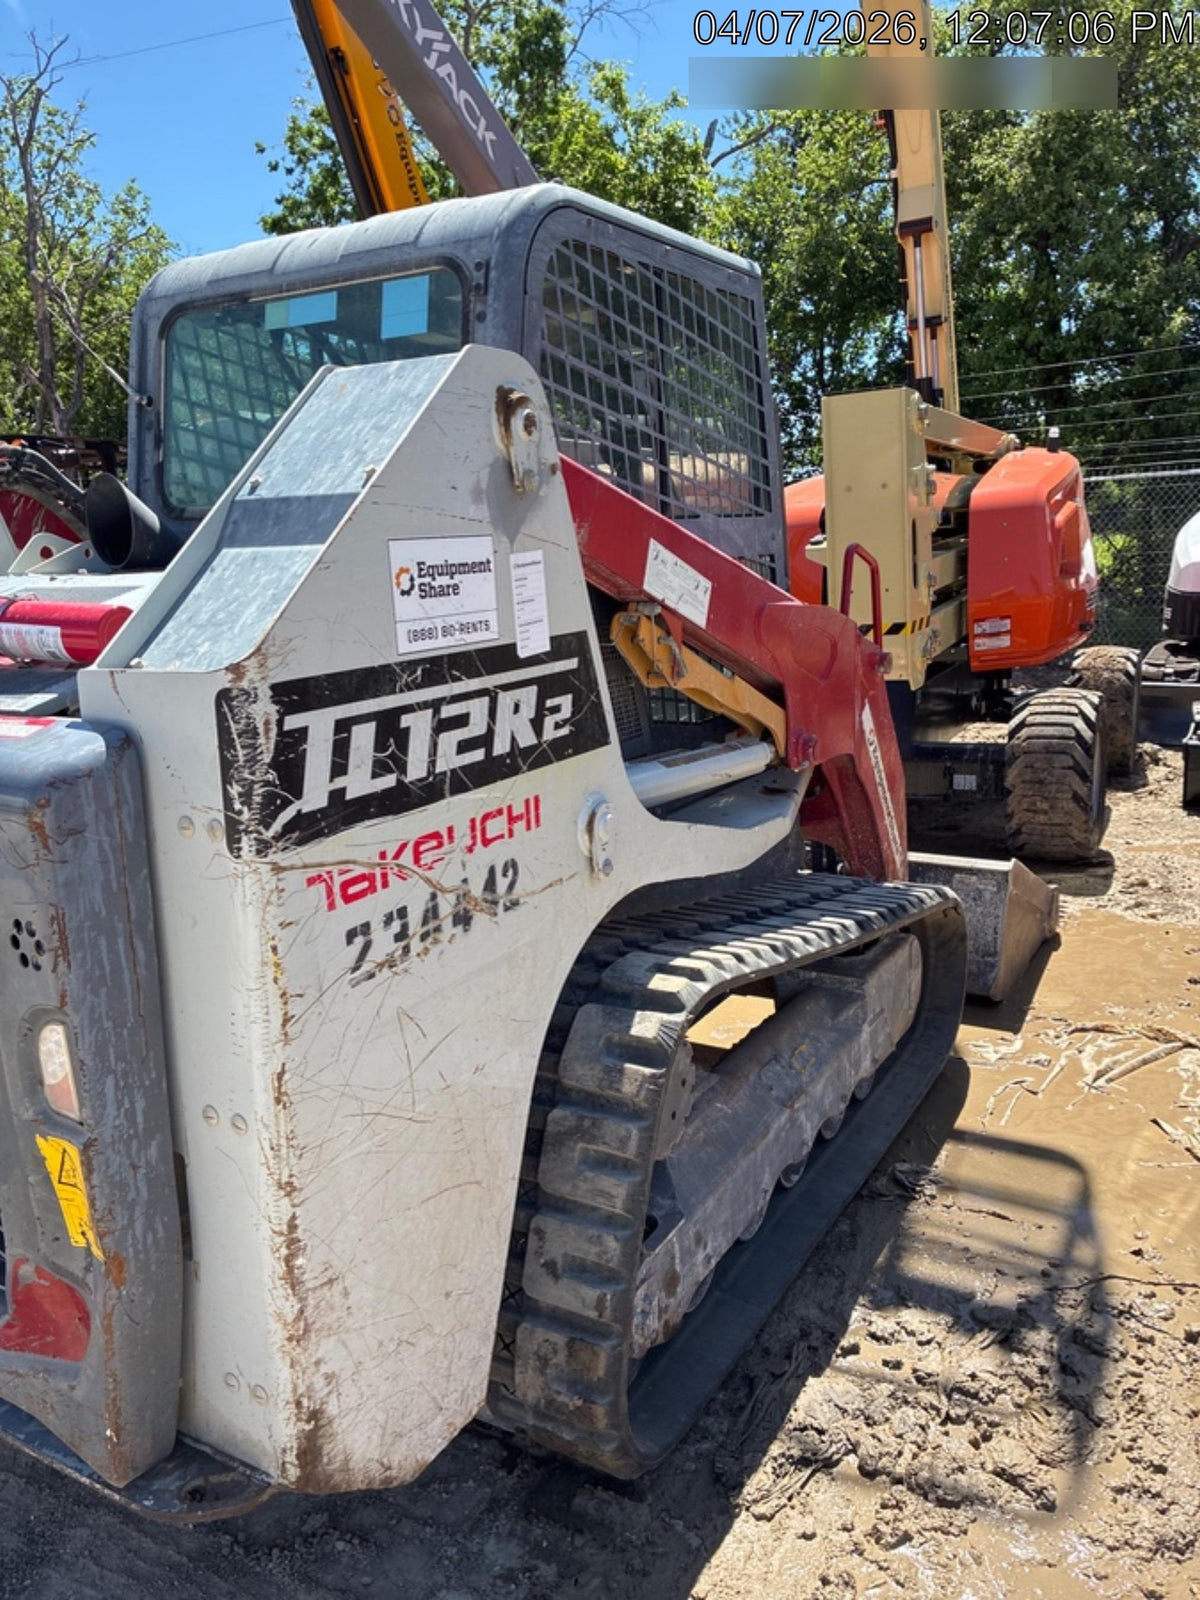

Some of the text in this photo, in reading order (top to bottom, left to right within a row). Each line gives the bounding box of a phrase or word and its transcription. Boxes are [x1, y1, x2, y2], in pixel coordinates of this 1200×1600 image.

[416, 558, 492, 581] Equipment
[418, 581, 460, 599] Share
[407, 619, 491, 644] (888) 80-RENTS
